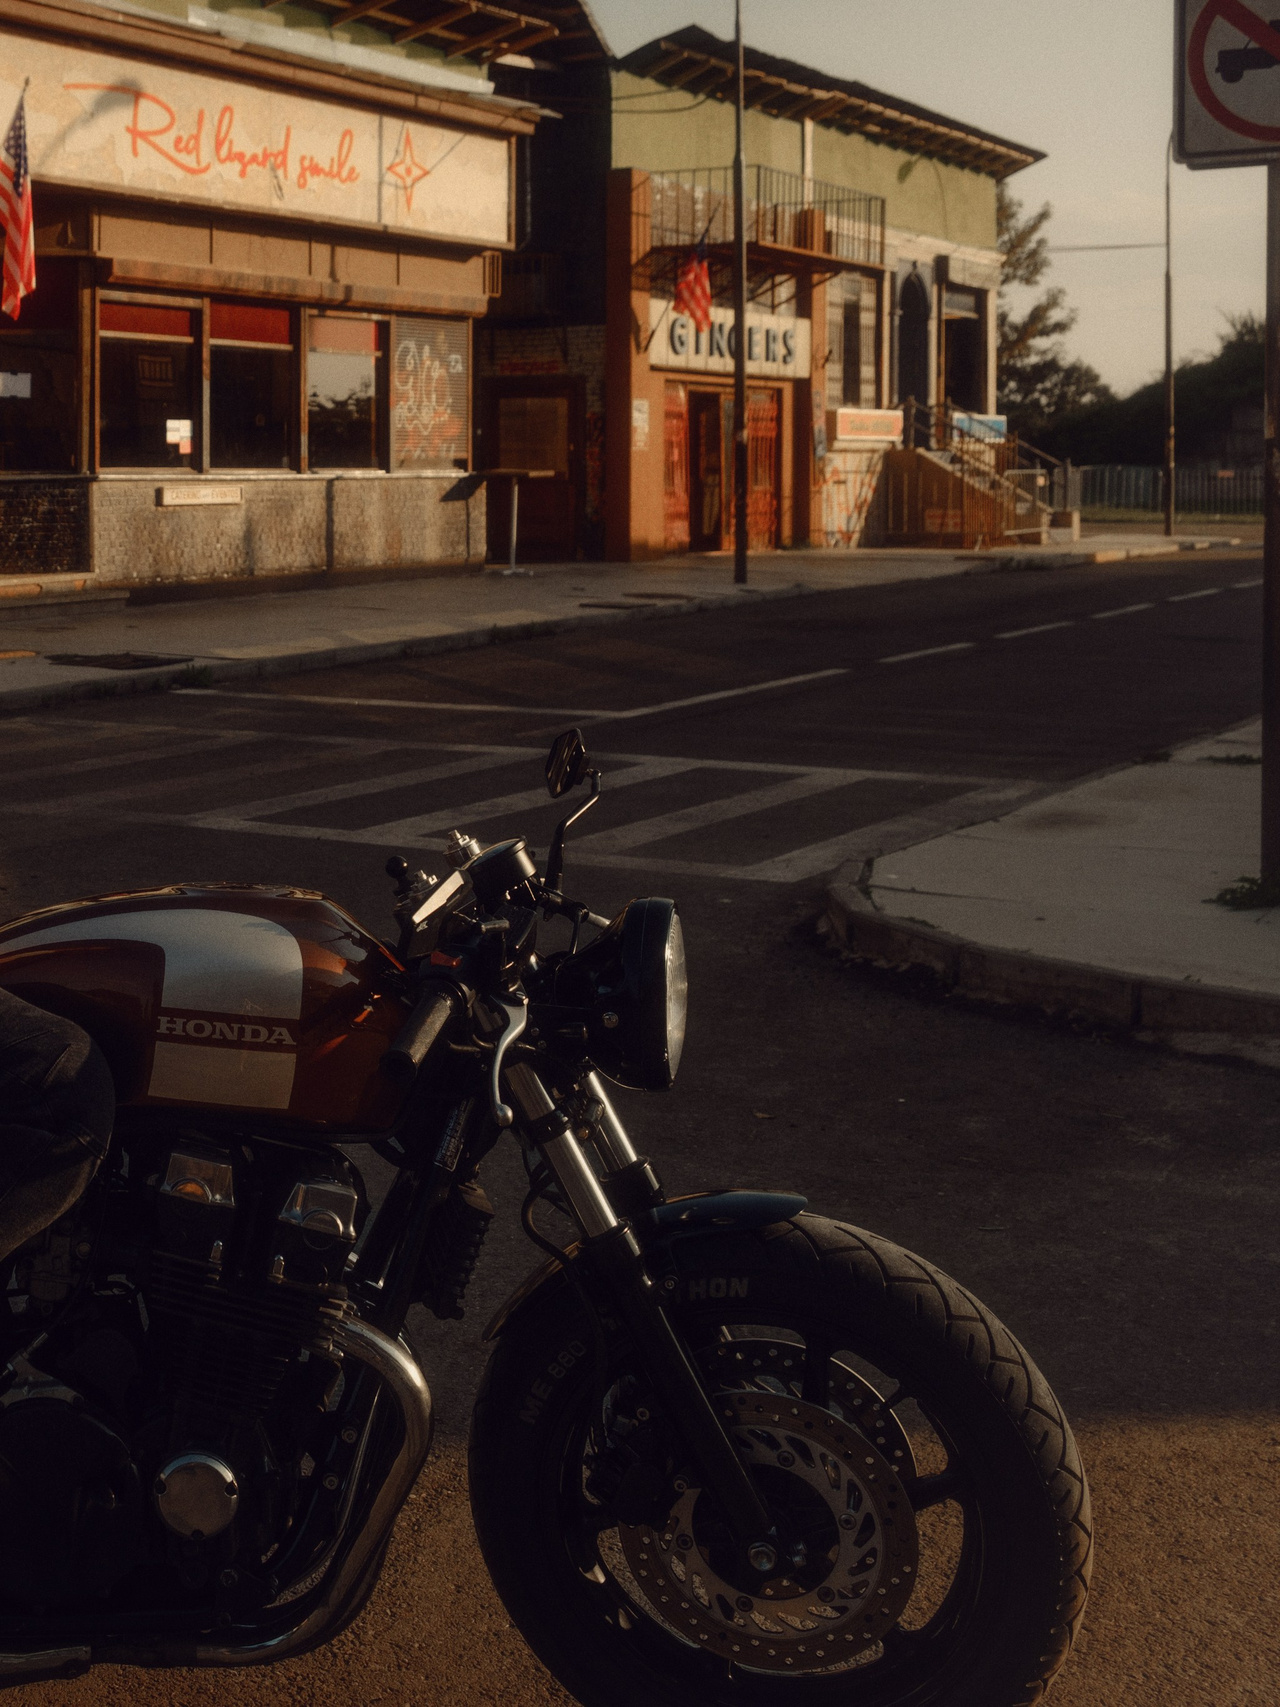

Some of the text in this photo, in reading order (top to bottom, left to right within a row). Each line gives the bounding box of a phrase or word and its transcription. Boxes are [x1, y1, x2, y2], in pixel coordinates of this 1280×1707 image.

[63, 83, 360, 188] Red lizard smile
[156, 1016, 297, 1045] HONDA
[520, 1340, 586, 1425] ME 880
